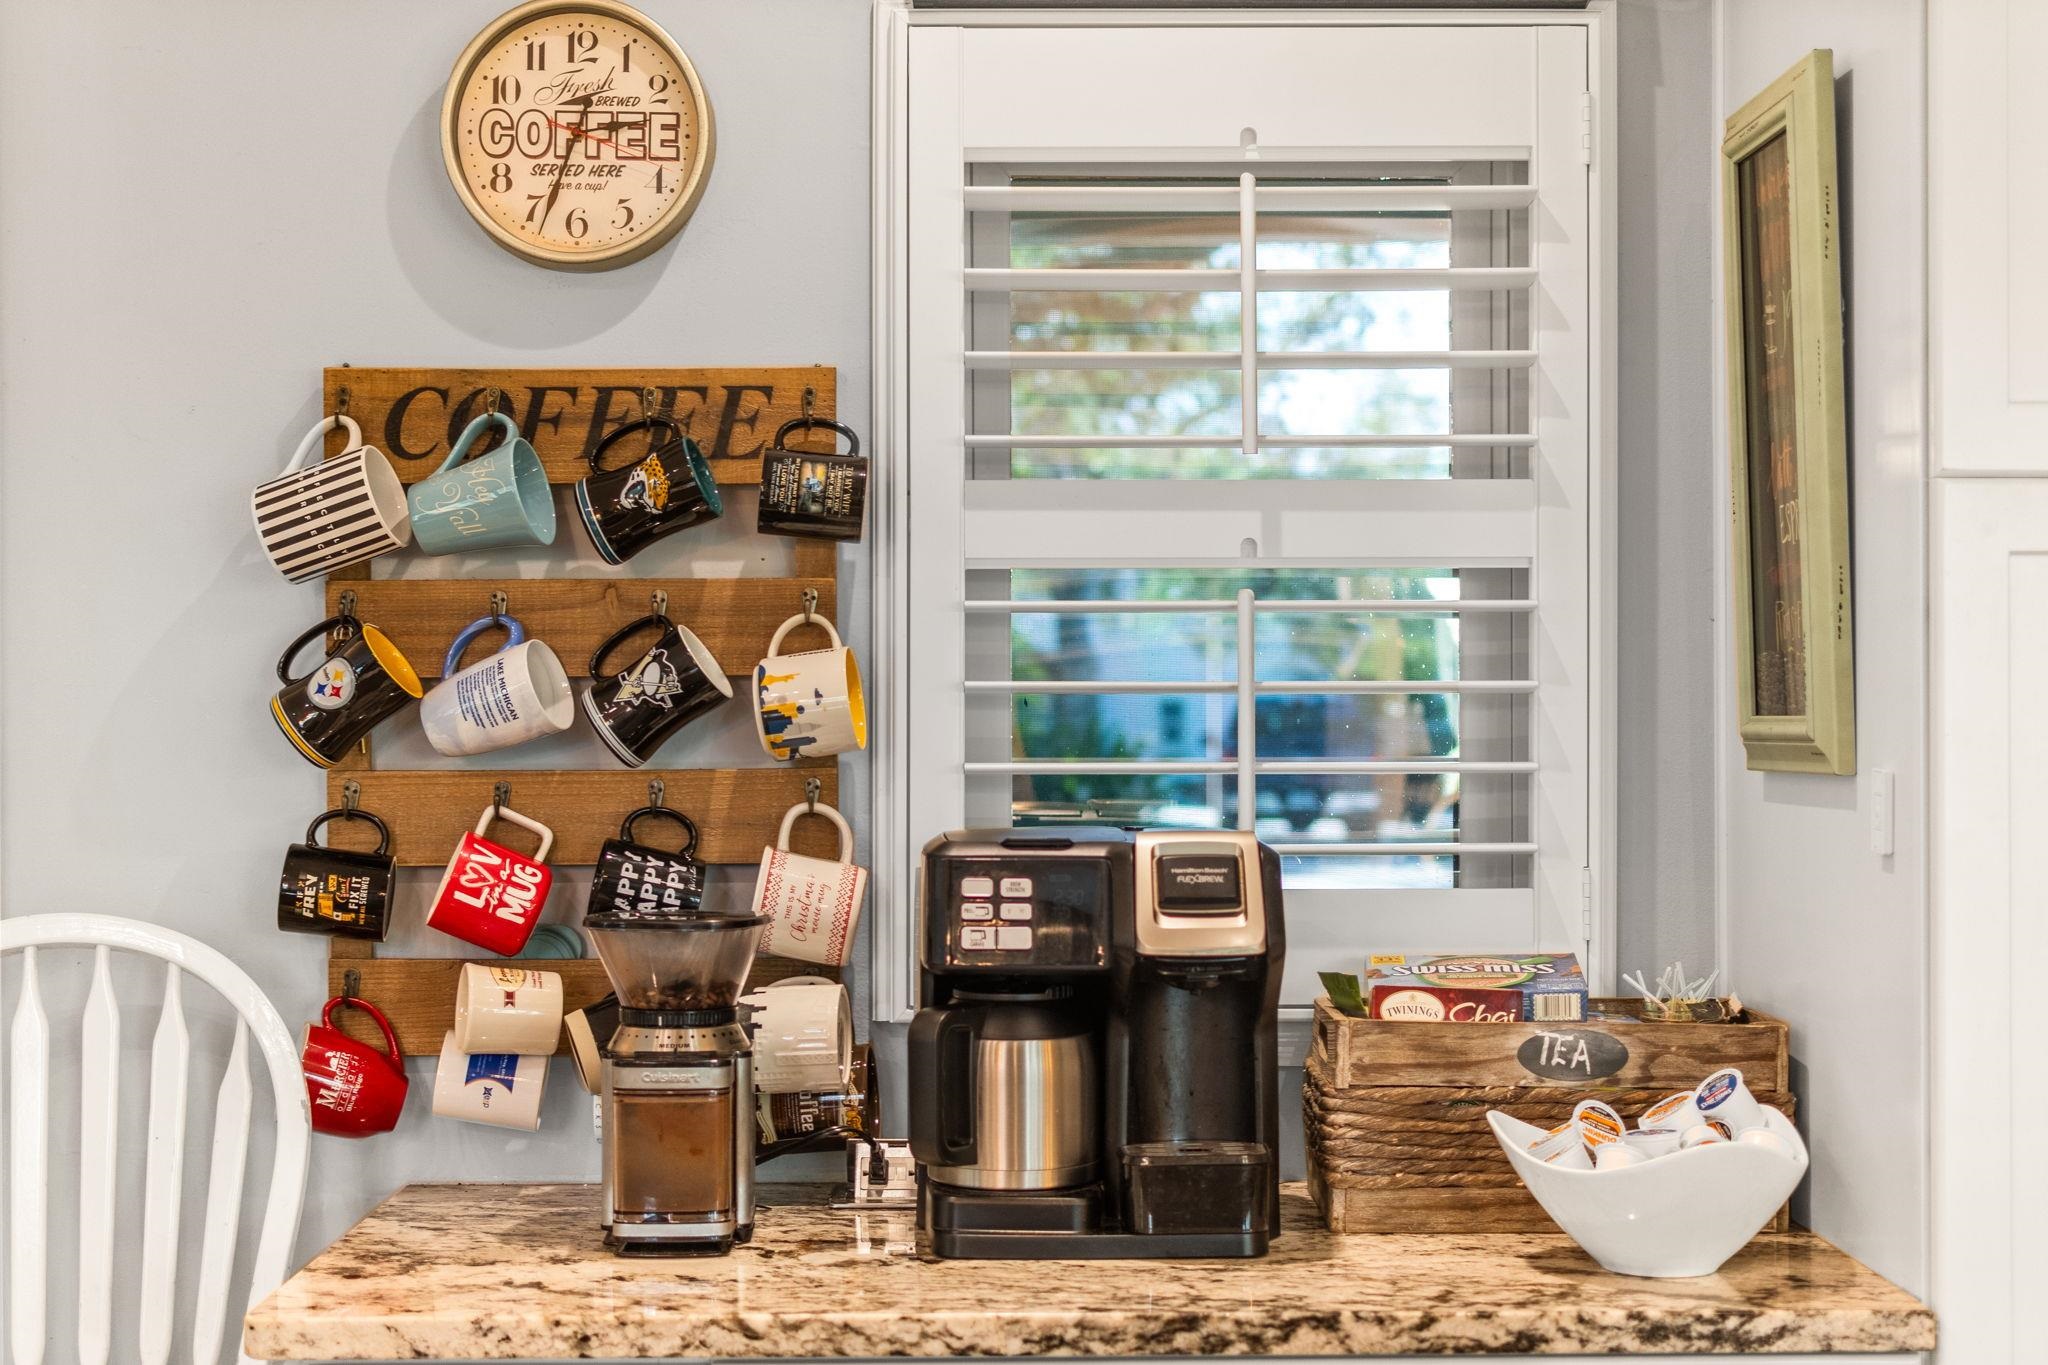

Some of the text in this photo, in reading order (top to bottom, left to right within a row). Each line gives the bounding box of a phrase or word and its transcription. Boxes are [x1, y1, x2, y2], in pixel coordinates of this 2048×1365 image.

[526, 41, 546, 71] 11
[566, 30, 599, 64] 12
[622, 43, 630, 73] 1
[491, 75, 521, 105] 10
[534, 66, 617, 106] Fresh
[649, 74, 669, 105] 2
[595, 96, 641, 108] BREWED
[479, 108, 681, 161] COFFEE
[490, 163, 513, 194] 8
[530, 164, 626, 178] SERVED HERE
[575, 183, 583, 191] a
[584, 180, 608, 193] cup!
[644, 164, 668, 194] 4
[525, 193, 548, 223] 7
[565, 207, 588, 239] 6
[612, 198, 634, 230] 5
[384, 386, 774, 460] COFFEE
[499, 677, 520, 721] MICHIGAN
[348, 876, 362, 910] FIX IT
[359, 877, 370, 905] SCREWED
[495, 864, 543, 925] MUG
[784, 906, 792, 920] THIS
[1386, 1007, 1439, 1019] TWININGS
[1450, 1002, 1516, 1022] Chai
[1536, 1031, 1592, 1075] TEA
[800, 1090, 819, 1132] offee
